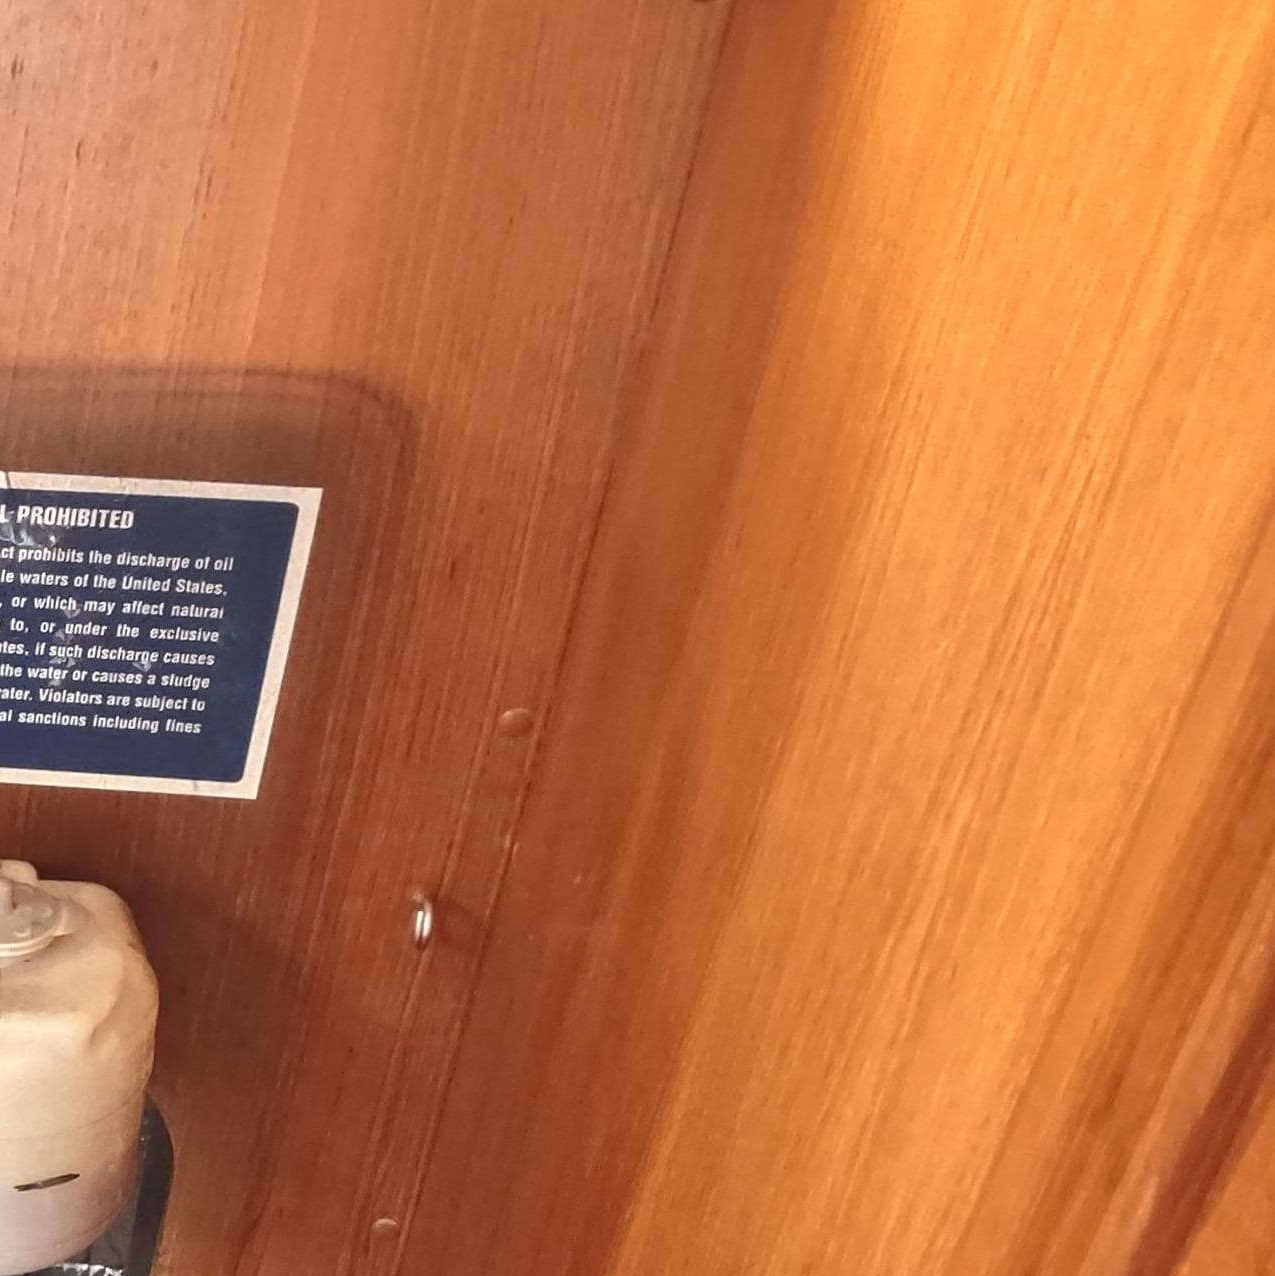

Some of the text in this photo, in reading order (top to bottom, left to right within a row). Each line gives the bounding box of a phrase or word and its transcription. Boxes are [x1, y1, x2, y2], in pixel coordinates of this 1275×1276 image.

[16, 503, 135, 530] PROHIBITED
[17, 545, 85, 566] prohibits
[87, 549, 113, 565] the
[115, 550, 191, 571] discharge
[193, 554, 210, 570] of
[212, 556, 234, 571] oil
[18, 569, 69, 587] waters
[72, 572, 89, 588] of
[92, 573, 117, 589] the
[120, 575, 171, 592] United
[174, 578, 229, 596] States,
[10, 596, 27, 608] or
[32, 594, 78, 611] which
[82, 600, 116, 615] may
[121, 599, 165, 616] affect
[170, 602, 225, 619] natural
[8, 616, 30, 632] to,
[39, 621, 56, 633] or
[64, 620, 108, 636] under
[115, 623, 140, 638] the
[148, 624, 220, 643] exclusive
[34, 641, 46, 655] if
[48, 642, 83, 658] such
[86, 644, 160, 664] discharge
[162, 651, 215, 666] causes
[26, 663, 69, 680] water
[71, 669, 88, 681] or
[90, 670, 143, 685] causes
[146, 674, 156, 685] a
[159, 672, 210, 691] sludge
[37, 687, 104, 705] Violators
[105, 694, 131, 707] are
[133, 693, 188, 712] subject
[190, 696, 206, 711] to
[17, 708, 87, 726] sanctions
[91, 713, 159, 733] including
[164, 718, 202, 734] fines
